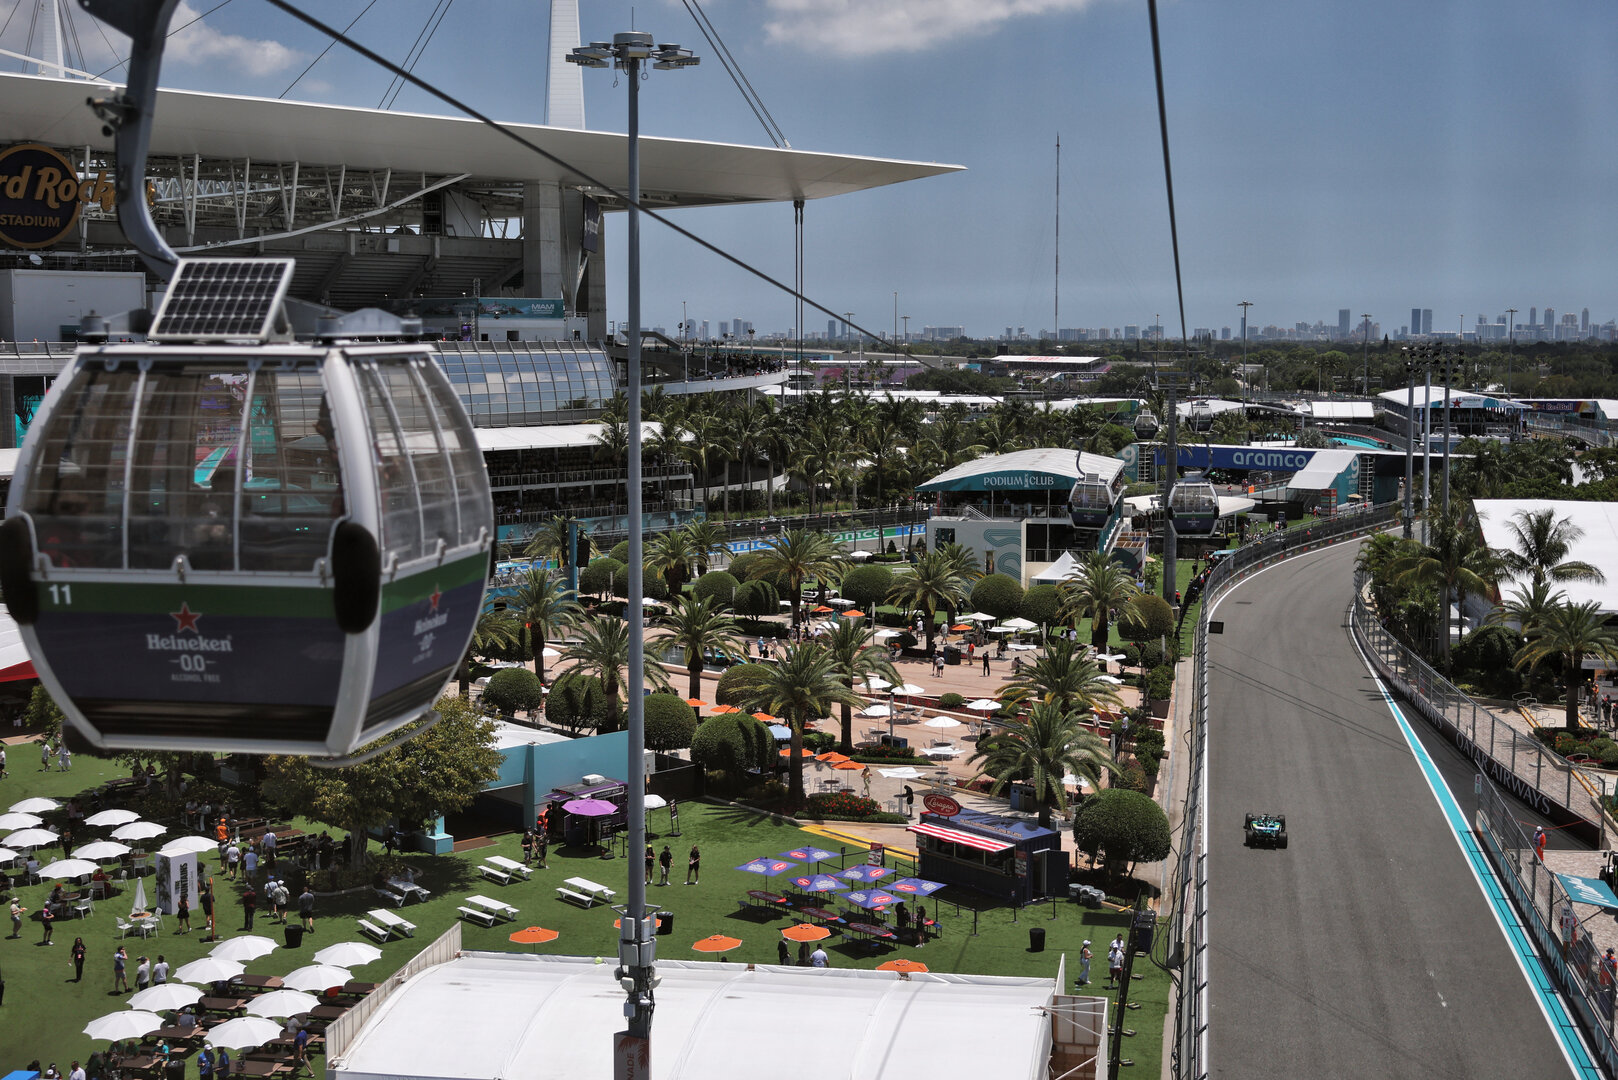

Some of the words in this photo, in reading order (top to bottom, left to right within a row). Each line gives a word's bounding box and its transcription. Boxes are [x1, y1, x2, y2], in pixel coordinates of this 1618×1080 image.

[1, 214, 60, 227] STADIUM
[1121, 445, 1137, 467] 9
[1232, 451, 1307, 467] aramco
[983, 476, 1023, 486] PODIUM
[1029, 475, 1054, 486] CLUB
[49, 584, 72, 605] 11
[145, 633, 232, 651] Heineken
[1456, 732, 1489, 770] QATAR
[1490, 760, 1550, 815] AIRWAYS
[180, 863, 188, 898] OUNTAINS
[1528, 907, 1574, 999] AIRWAYS
